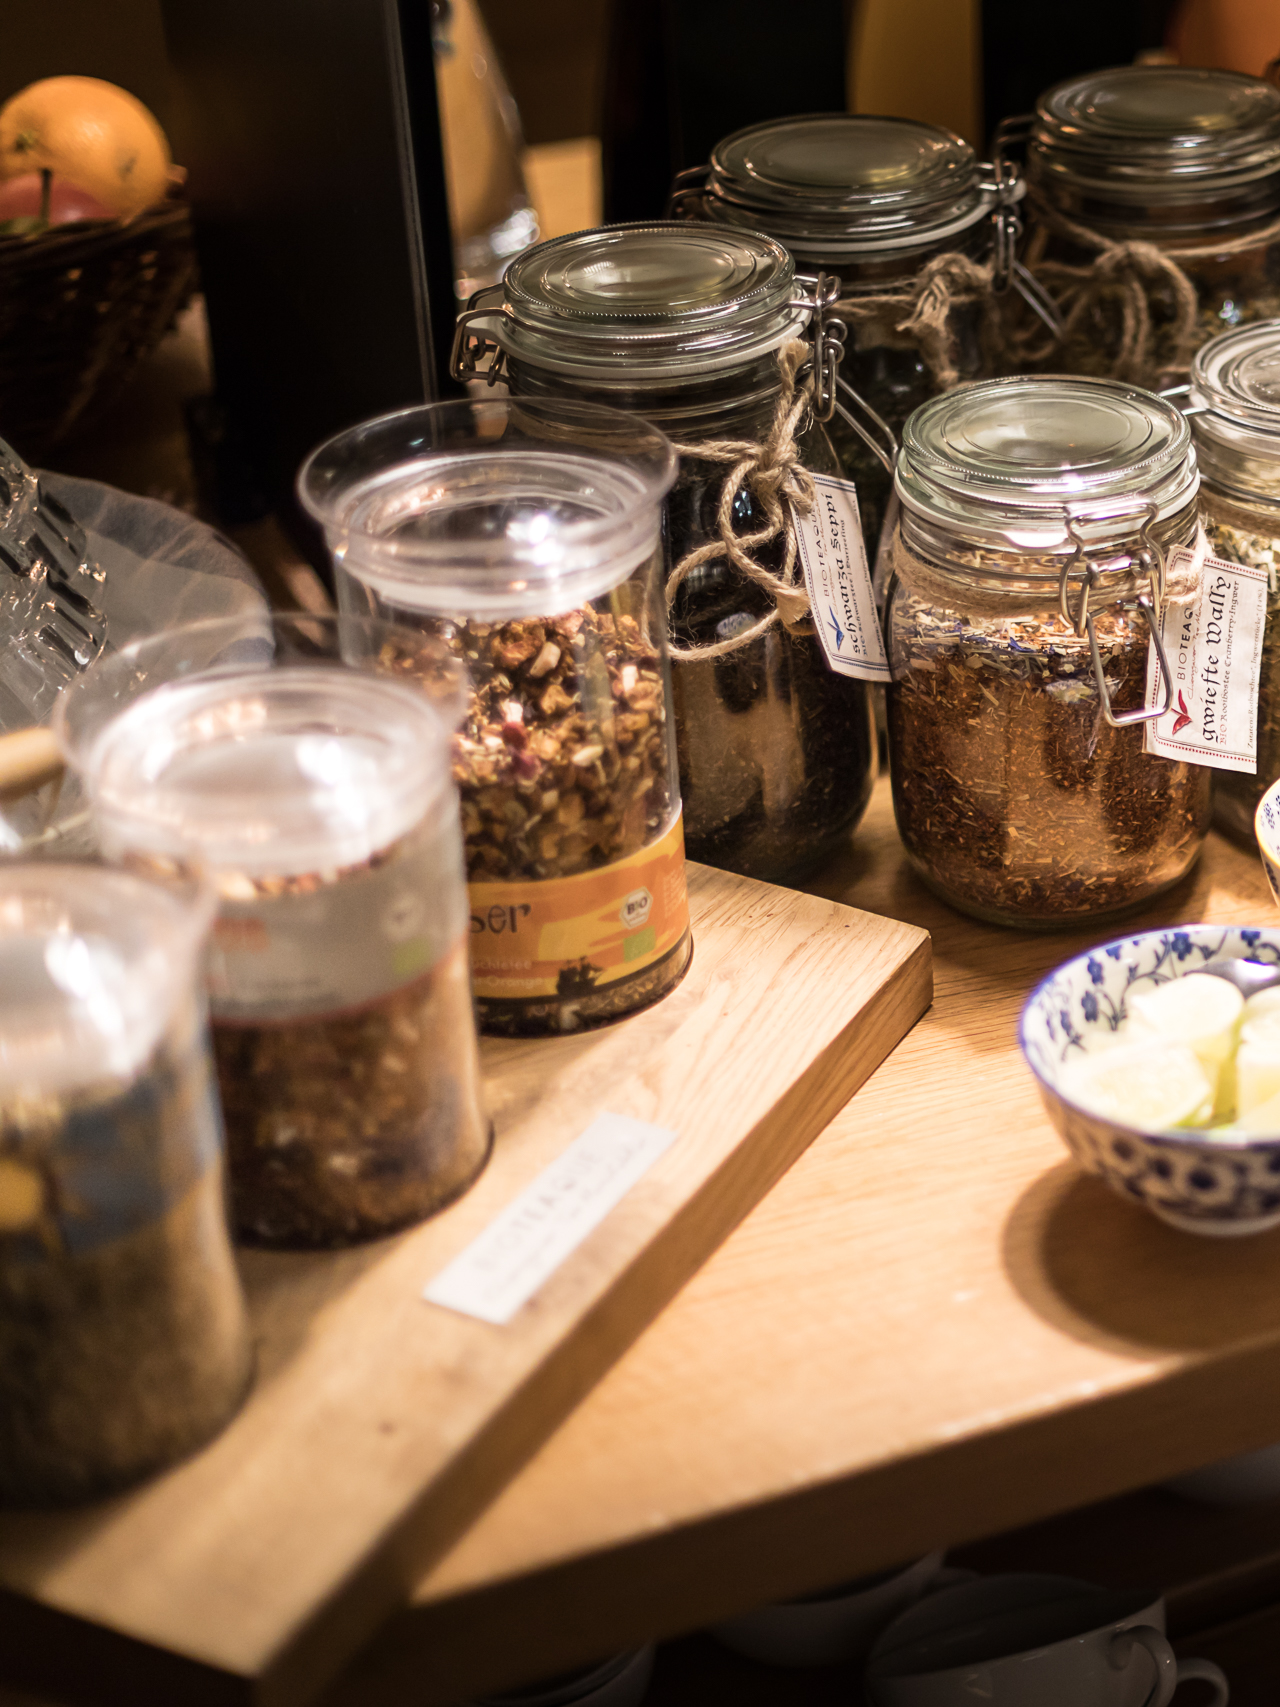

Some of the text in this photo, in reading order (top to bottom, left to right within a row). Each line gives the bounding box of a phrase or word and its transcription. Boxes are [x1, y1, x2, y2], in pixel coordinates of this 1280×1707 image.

[820, 493, 861, 654] schwarza Seppi
[1225, 581, 1240, 667] Cranberry-Ingwer
[1200, 576, 1231, 744] gwiefte Wally
[1220, 670, 1231, 722] Rooibostee
[471, 903, 531, 935] ser
[627, 896, 648, 915] BIO
